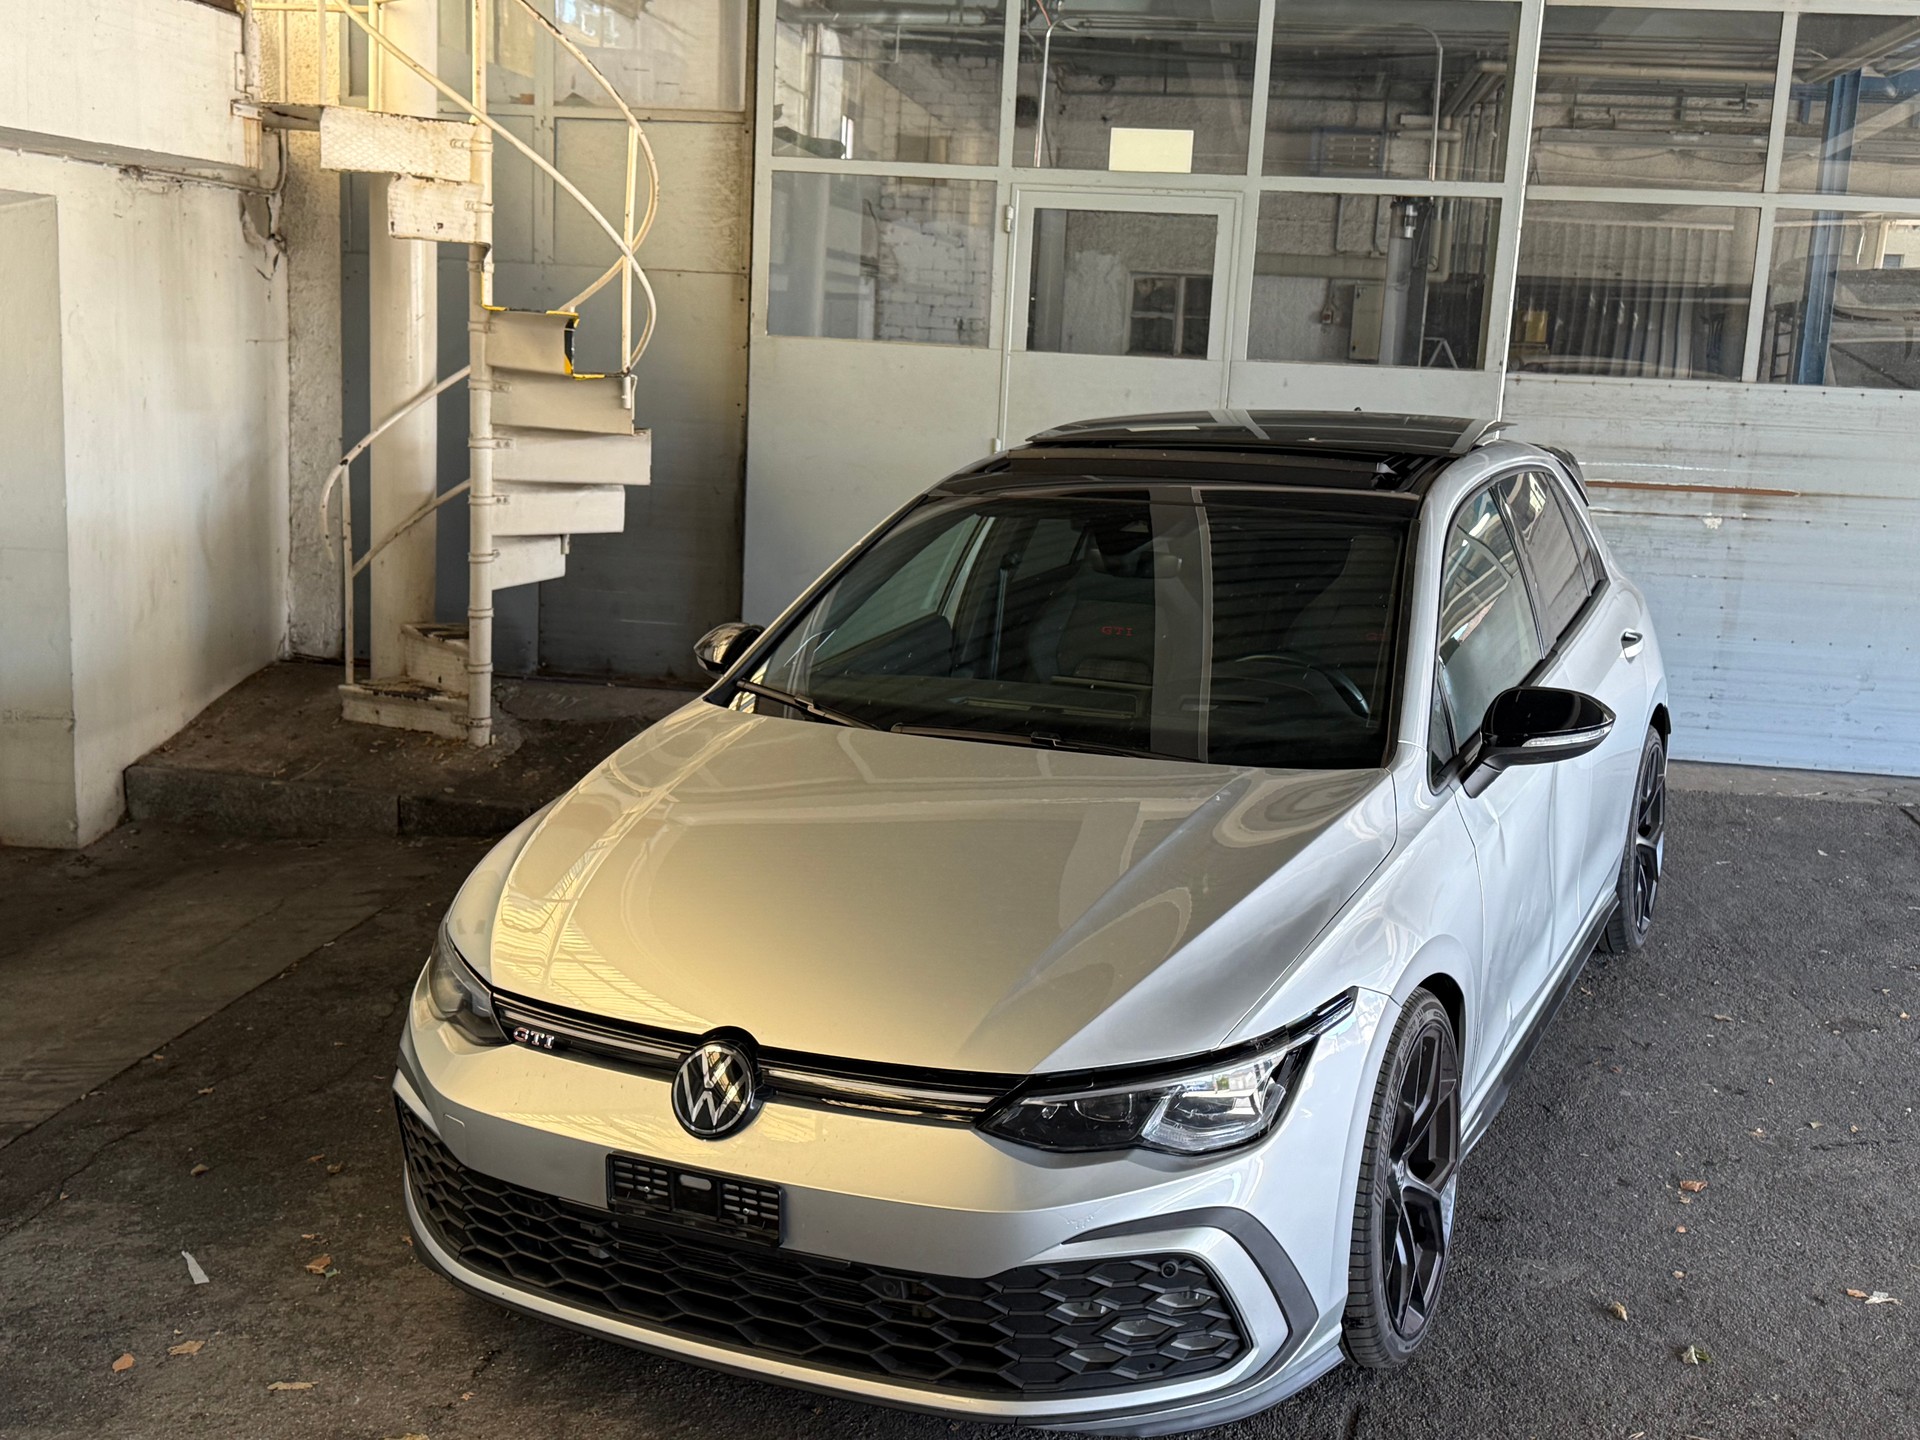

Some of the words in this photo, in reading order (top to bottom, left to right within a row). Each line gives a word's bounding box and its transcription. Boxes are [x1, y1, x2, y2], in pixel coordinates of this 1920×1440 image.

[1099, 625, 1136, 637] GTI
[513, 1026, 555, 1050] GTI
[677, 1043, 750, 1132] VW
